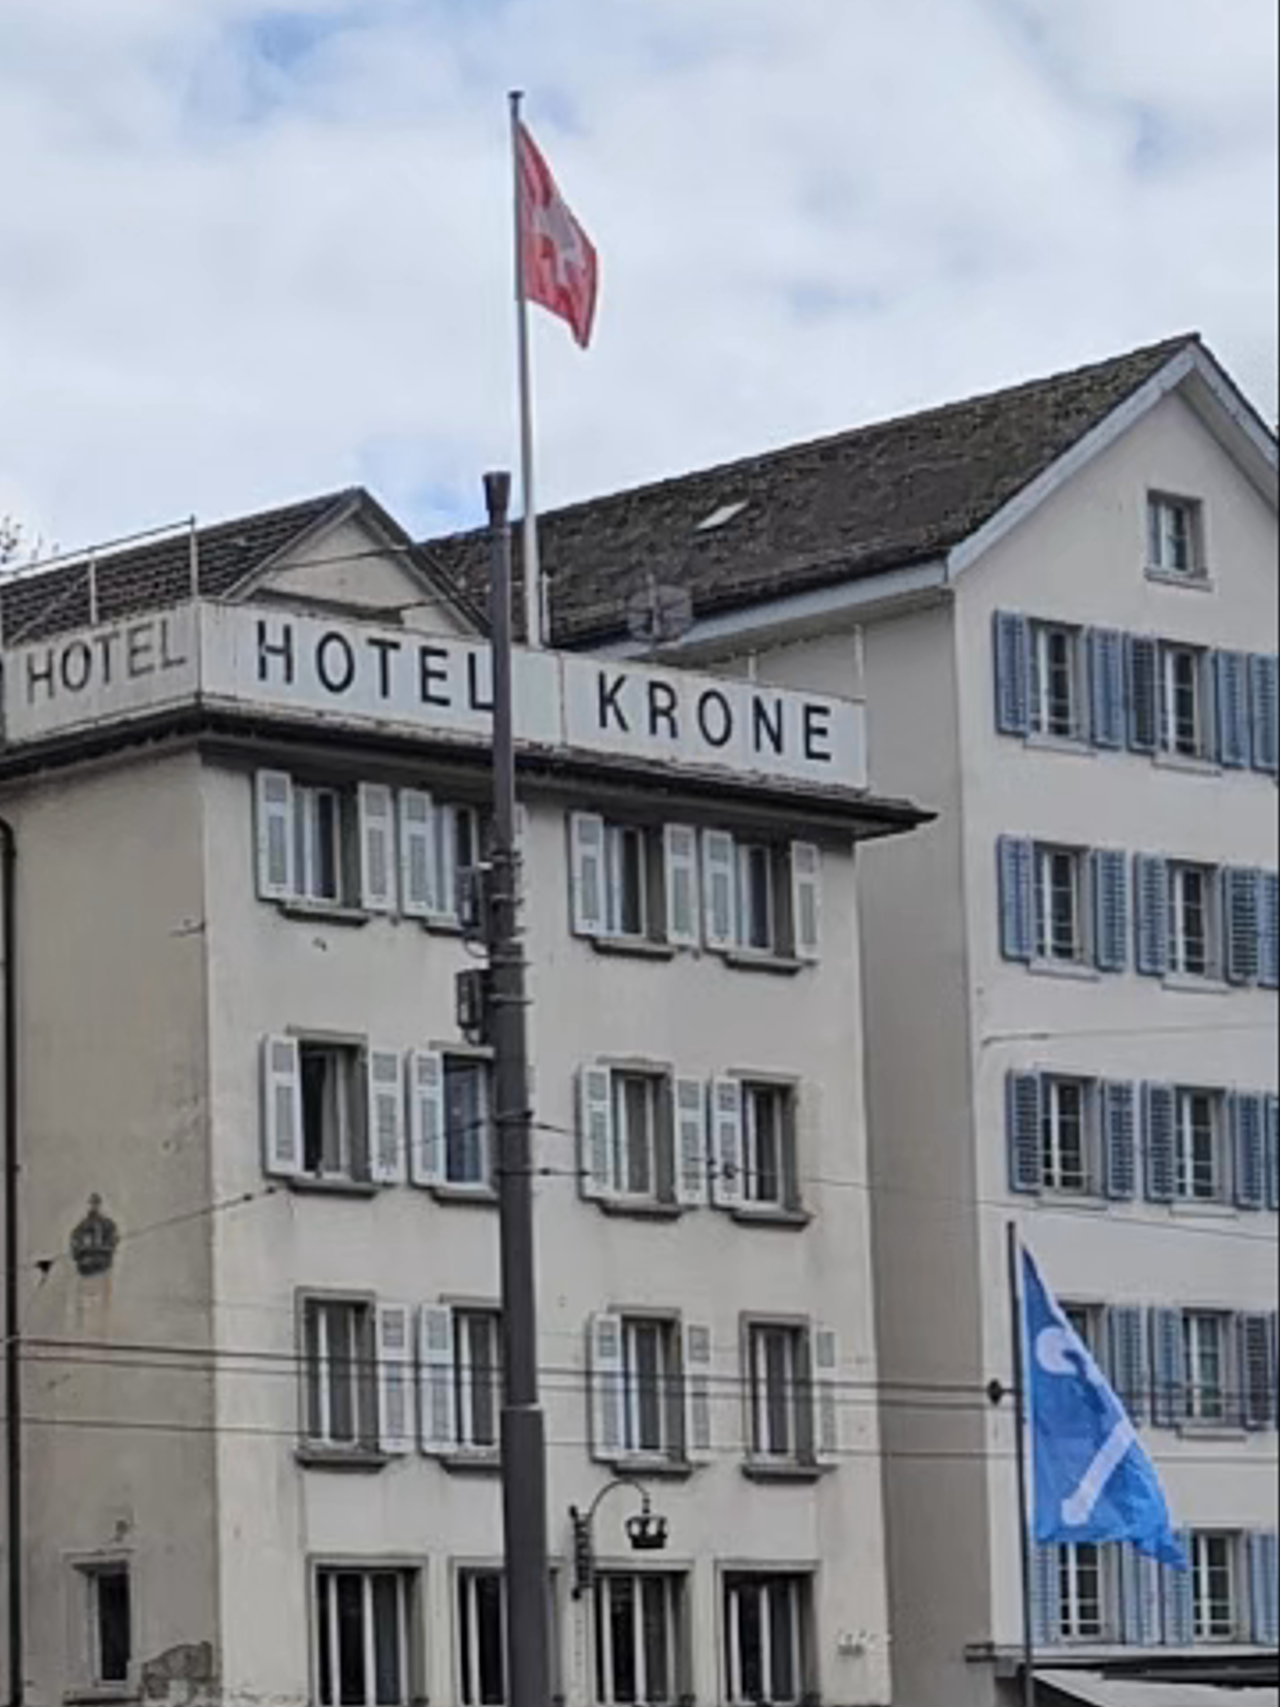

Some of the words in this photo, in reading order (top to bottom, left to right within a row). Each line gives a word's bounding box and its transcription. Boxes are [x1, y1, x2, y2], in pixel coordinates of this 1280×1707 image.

[26, 618, 187, 705] HOTEL
[256, 619, 494, 711] HOTEL
[597, 670, 832, 762] KRONE
